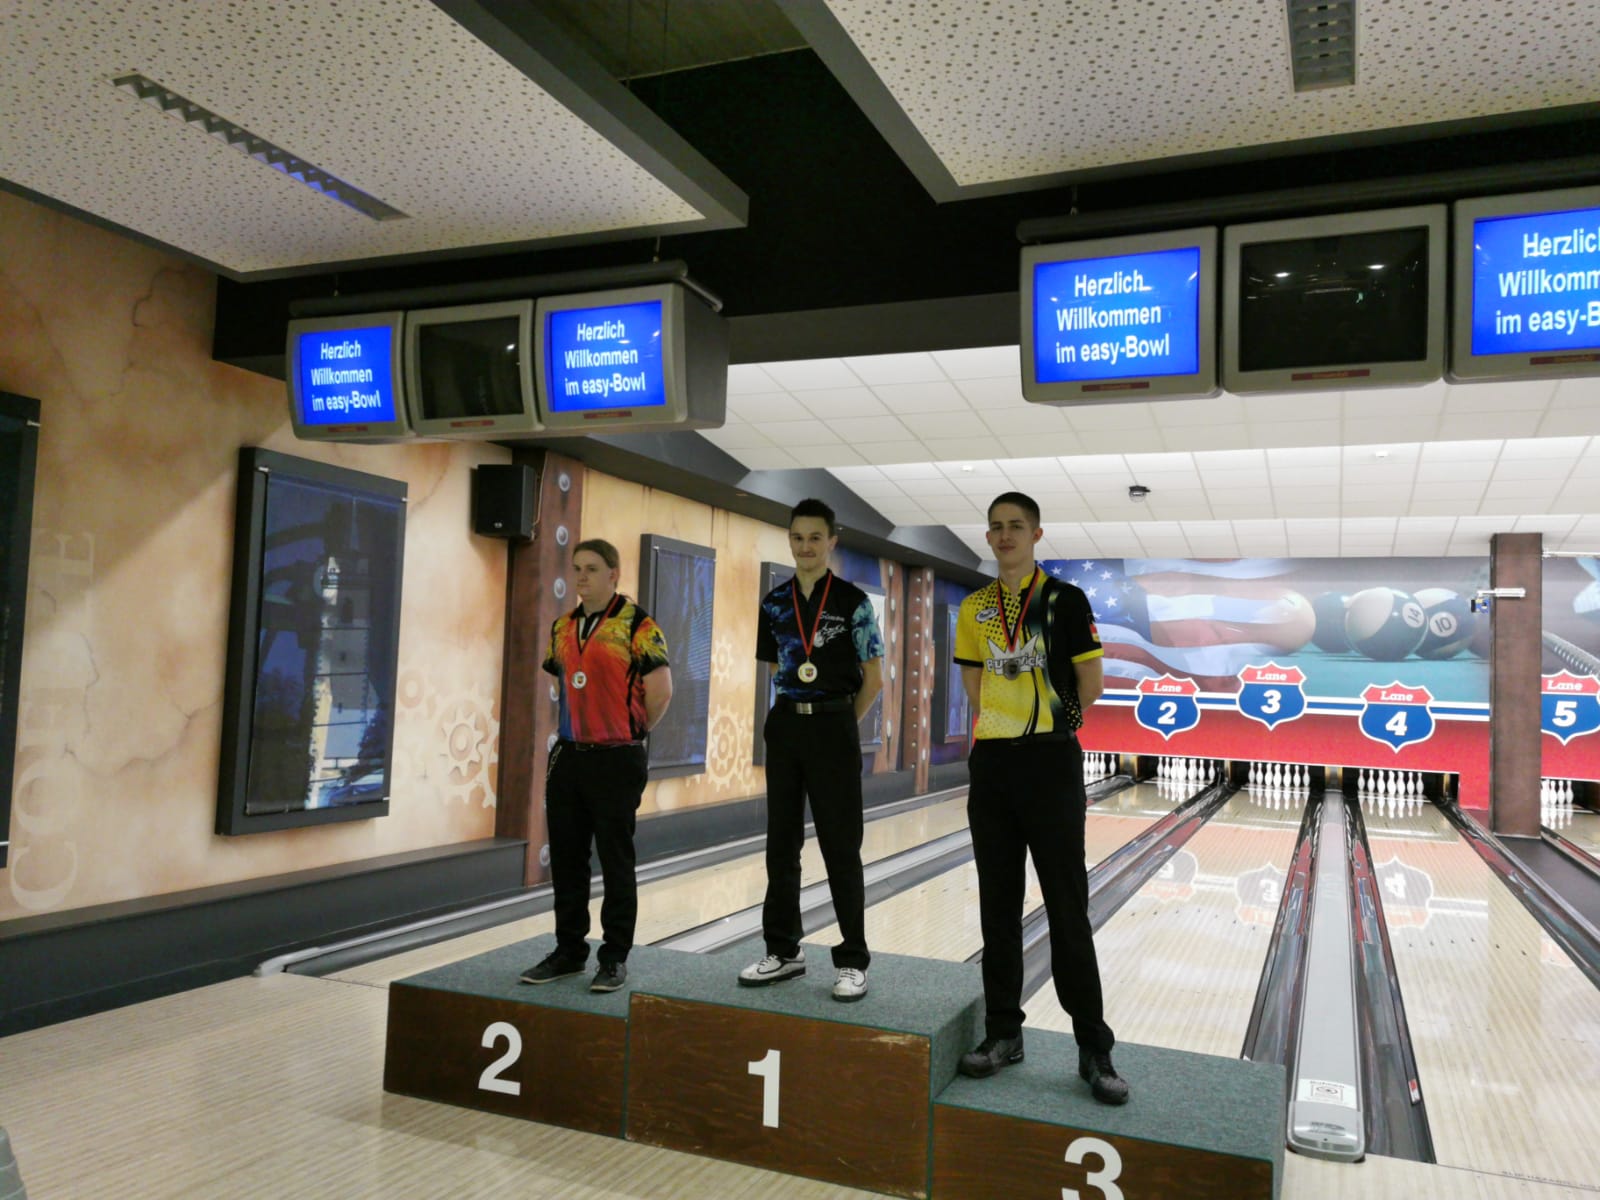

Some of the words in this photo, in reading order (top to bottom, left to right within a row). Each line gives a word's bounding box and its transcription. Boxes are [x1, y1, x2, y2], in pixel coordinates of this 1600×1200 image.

[1074, 270, 1143, 297] Herzlich
[1056, 303, 1161, 332] Willkommen
[1496, 310, 1521, 334] im
[577, 319, 626, 342] Herzlich
[320, 341, 361, 360] Herzlich
[564, 347, 638, 369] Willkommen
[1055, 341, 1075, 364] im
[1081, 333, 1170, 366] easy-Bowl
[311, 366, 373, 386] Willkommen
[565, 378, 580, 396] im
[582, 374, 646, 398] easy-Bowl
[312, 396, 325, 411] im
[326, 389, 381, 413] easy-Bowl
[1434, 617, 1453, 633] 10
[1152, 680, 1184, 695] Lane
[1254, 668, 1289, 684] Lane
[1546, 677, 1588, 693] Lane
[1261, 689, 1282, 714] 3
[1378, 688, 1416, 703] Lane
[1157, 701, 1178, 725] 2
[1385, 711, 1408, 736] 4
[1552, 700, 1578, 728] 5
[478, 1021, 522, 1096] 2
[747, 1049, 780, 1128] 1
[1062, 1137, 1124, 1200] 3
